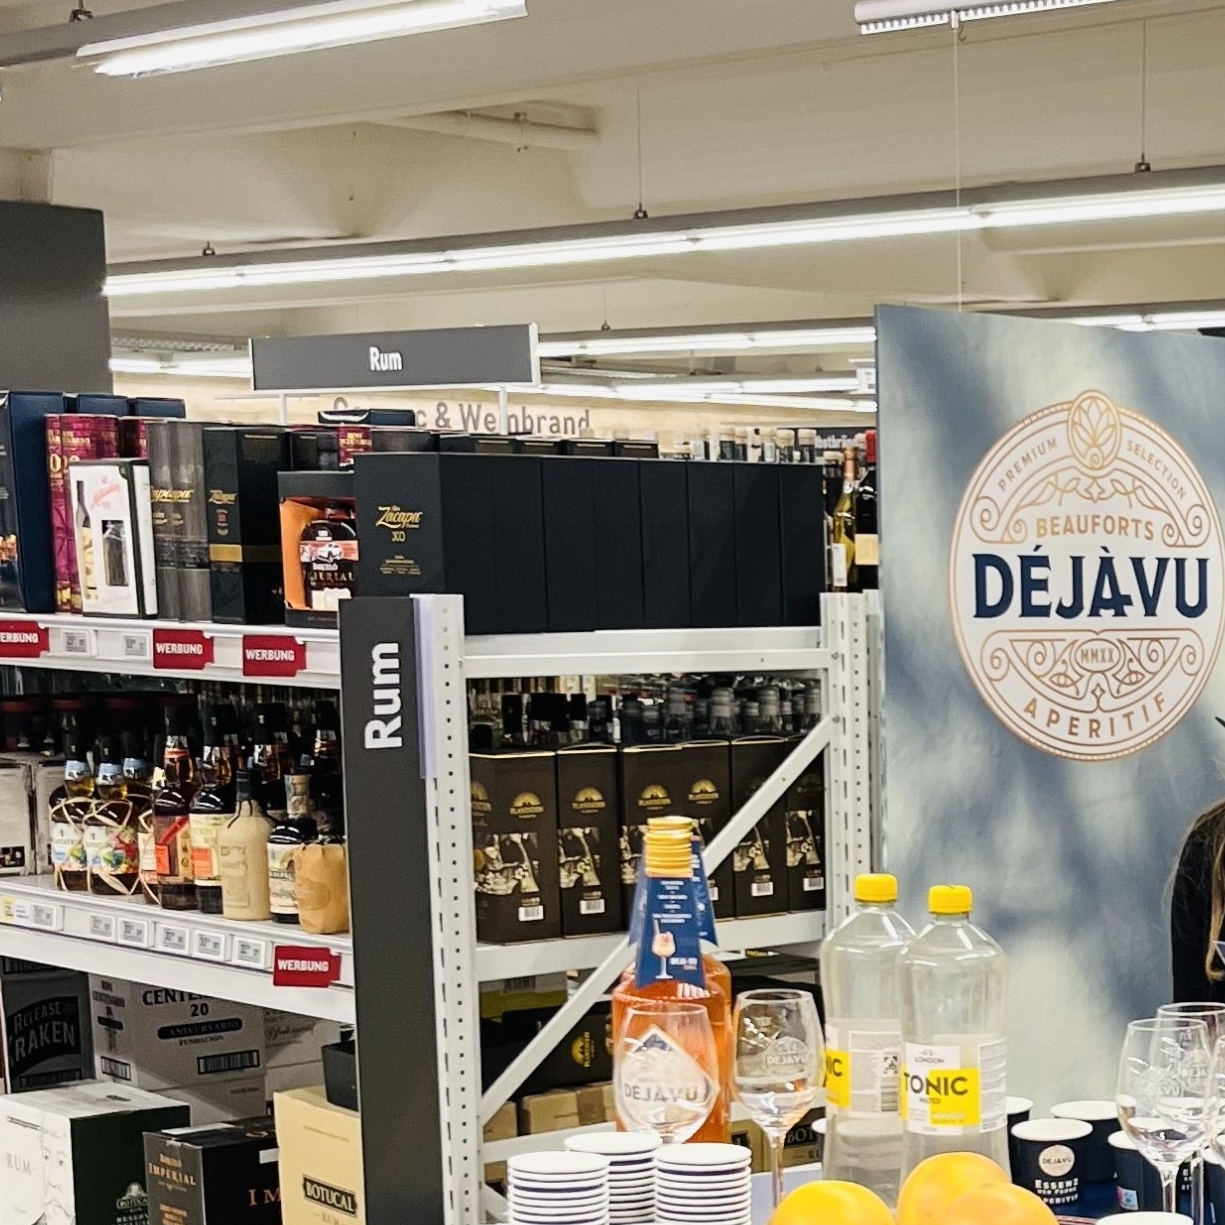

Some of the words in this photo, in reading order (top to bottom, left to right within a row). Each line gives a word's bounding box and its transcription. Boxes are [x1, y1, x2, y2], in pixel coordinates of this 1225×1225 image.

[369, 347, 402, 371] Rum
[436, 402, 451, 428] &
[459, 404, 590, 433] Wenbrand
[997, 437, 1058, 492] PREMIUM
[1125, 440, 1187, 500] SELECTION
[375, 505, 424, 529] Zacapa
[1036, 514, 1154, 541] BEAUFORTS
[156, 643, 204, 656] WERBUNG
[246, 648, 295, 661] WERBUNG
[1080, 646, 1115, 664] MMXX
[365, 642, 402, 750] Rum
[1023, 696, 1166, 739] APERITIF
[278, 960, 329, 973] WERBUNG
[13, 1002, 63, 1034] RELEASE
[190, 1003, 209, 1017] 20
[904, 1072, 968, 1096] TONIC
[7, 1153, 32, 1175] RUM
[149, 1163, 196, 1186] IMPERIAL
[305, 1179, 356, 1211] BOTUCAL
[1034, 1178, 1079, 1190] ESSENZ
